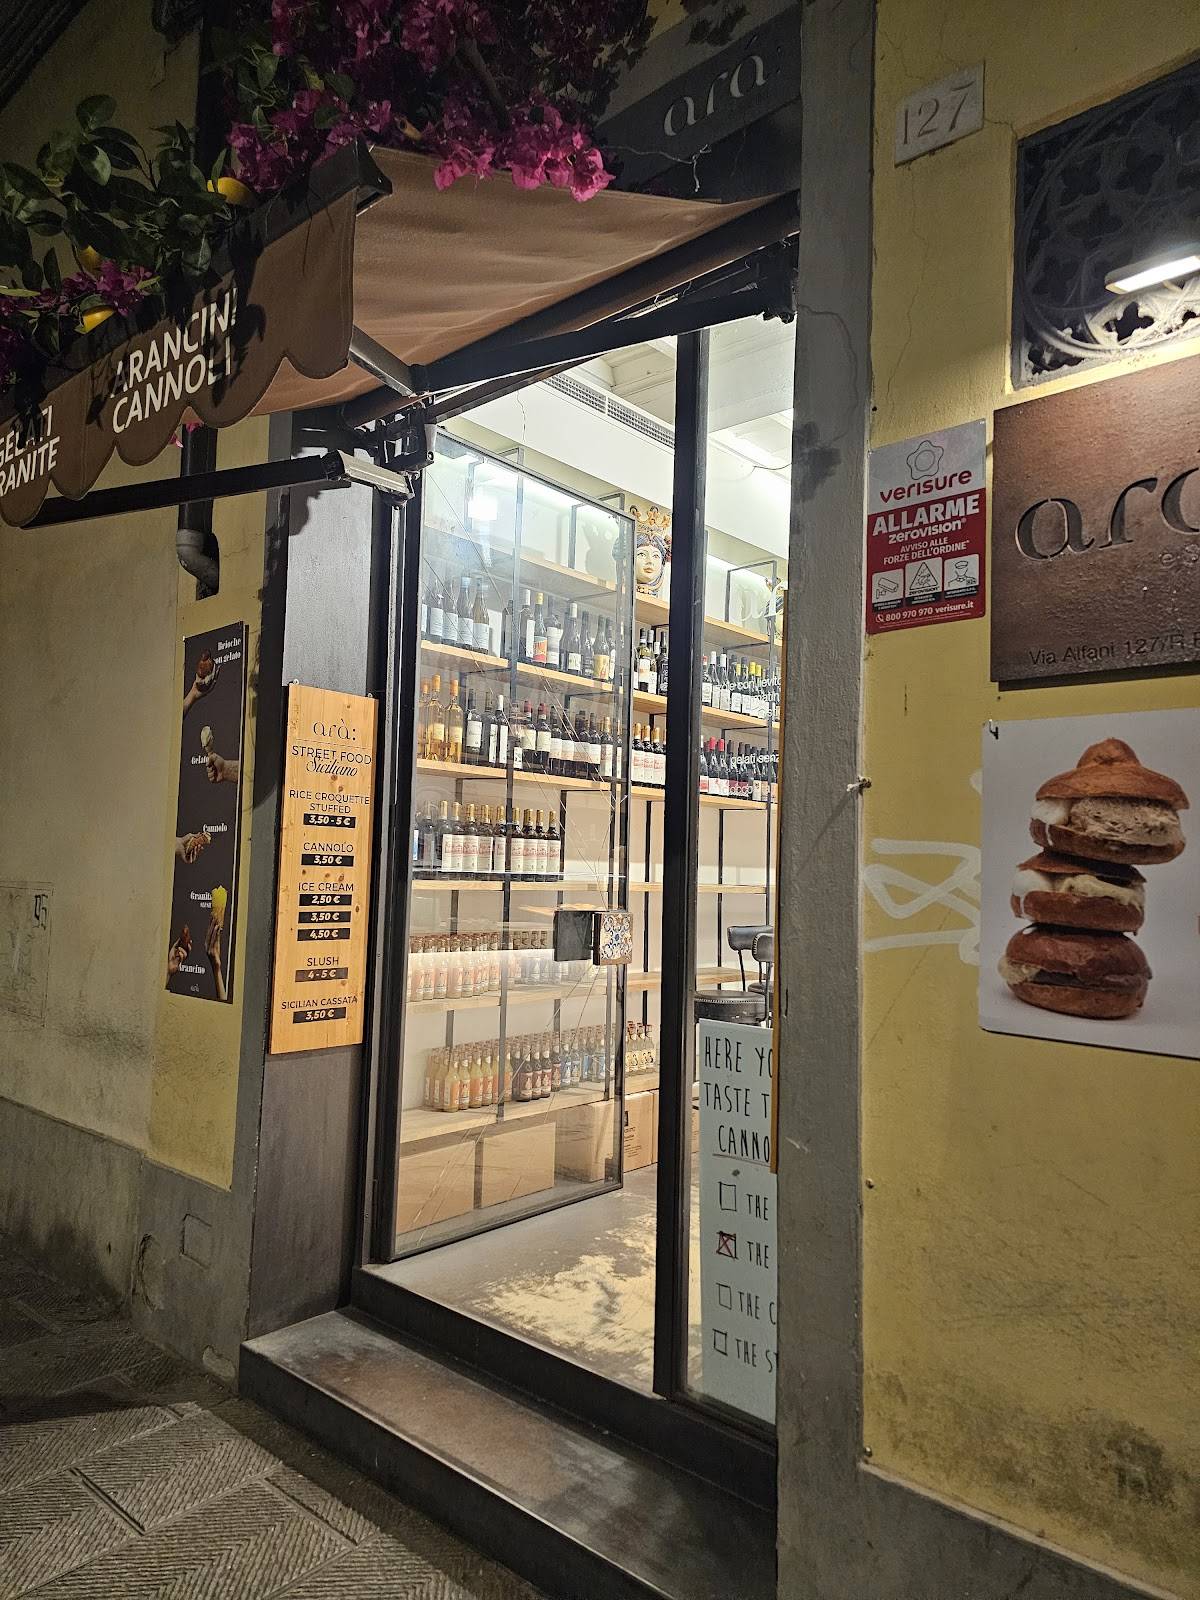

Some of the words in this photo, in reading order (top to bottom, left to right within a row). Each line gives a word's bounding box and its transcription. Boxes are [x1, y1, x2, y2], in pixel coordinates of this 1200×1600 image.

[903, 80, 976, 145] 127
[110, 287, 238, 399] ARANCINI
[112, 335, 232, 434] CANNOLI
[879, 470, 972, 504] verisure
[872, 493, 980, 536] ALLARME
[900, 541, 928, 553] AVVISO
[929, 537, 949, 547] ALLE
[883, 553, 910, 566] FORZE
[885, 613, 901, 622] 800
[902, 610, 917, 619] 970
[918, 607, 933, 616] 970
[935, 601, 974, 614] verisure.it
[1028, 650, 1056, 665] Via
[1062, 642, 1115, 662] Alfani
[291, 745, 337, 760] STREET
[340, 752, 372, 765] FOOD
[730, 752, 756, 769] gelati
[305, 756, 359, 777] Siciliano
[289, 789, 312, 800] RICE
[315, 792, 371, 805] CROQUETTE
[309, 803, 351, 814] STUFFED
[202, 823, 228, 833] Cannolo
[308, 815, 330, 825] 3,50
[336, 816, 342, 825] 5
[303, 842, 354, 853] CANNOLO
[313, 855, 334, 865] 3,50
[335, 856, 343, 864] €
[298, 882, 315, 892] ICE
[318, 883, 354, 892] CREAM
[311, 895, 332, 904] 2,50
[333, 896, 340, 904] €
[310, 912, 331, 922] 3,50
[332, 912, 339, 921] €
[309, 929, 330, 939] 4,50
[331, 929, 339, 938] €
[306, 956, 339, 967] SLUSH
[321, 970, 327, 978] 5
[281, 999, 318, 1010] SICILIAN
[320, 996, 358, 1006] CASSATA
[305, 1010, 326, 1020] 3,50
[327, 1009, 335, 1018] €
[704, 1036, 743, 1074] HERE
[703, 1082, 750, 1117] TASTE
[718, 1124, 770, 1164] CANNO
[746, 1193, 769, 1222] THE
[746, 1240, 769, 1270] THE
[738, 1290, 760, 1320] THE
[735, 1337, 757, 1369] THE
